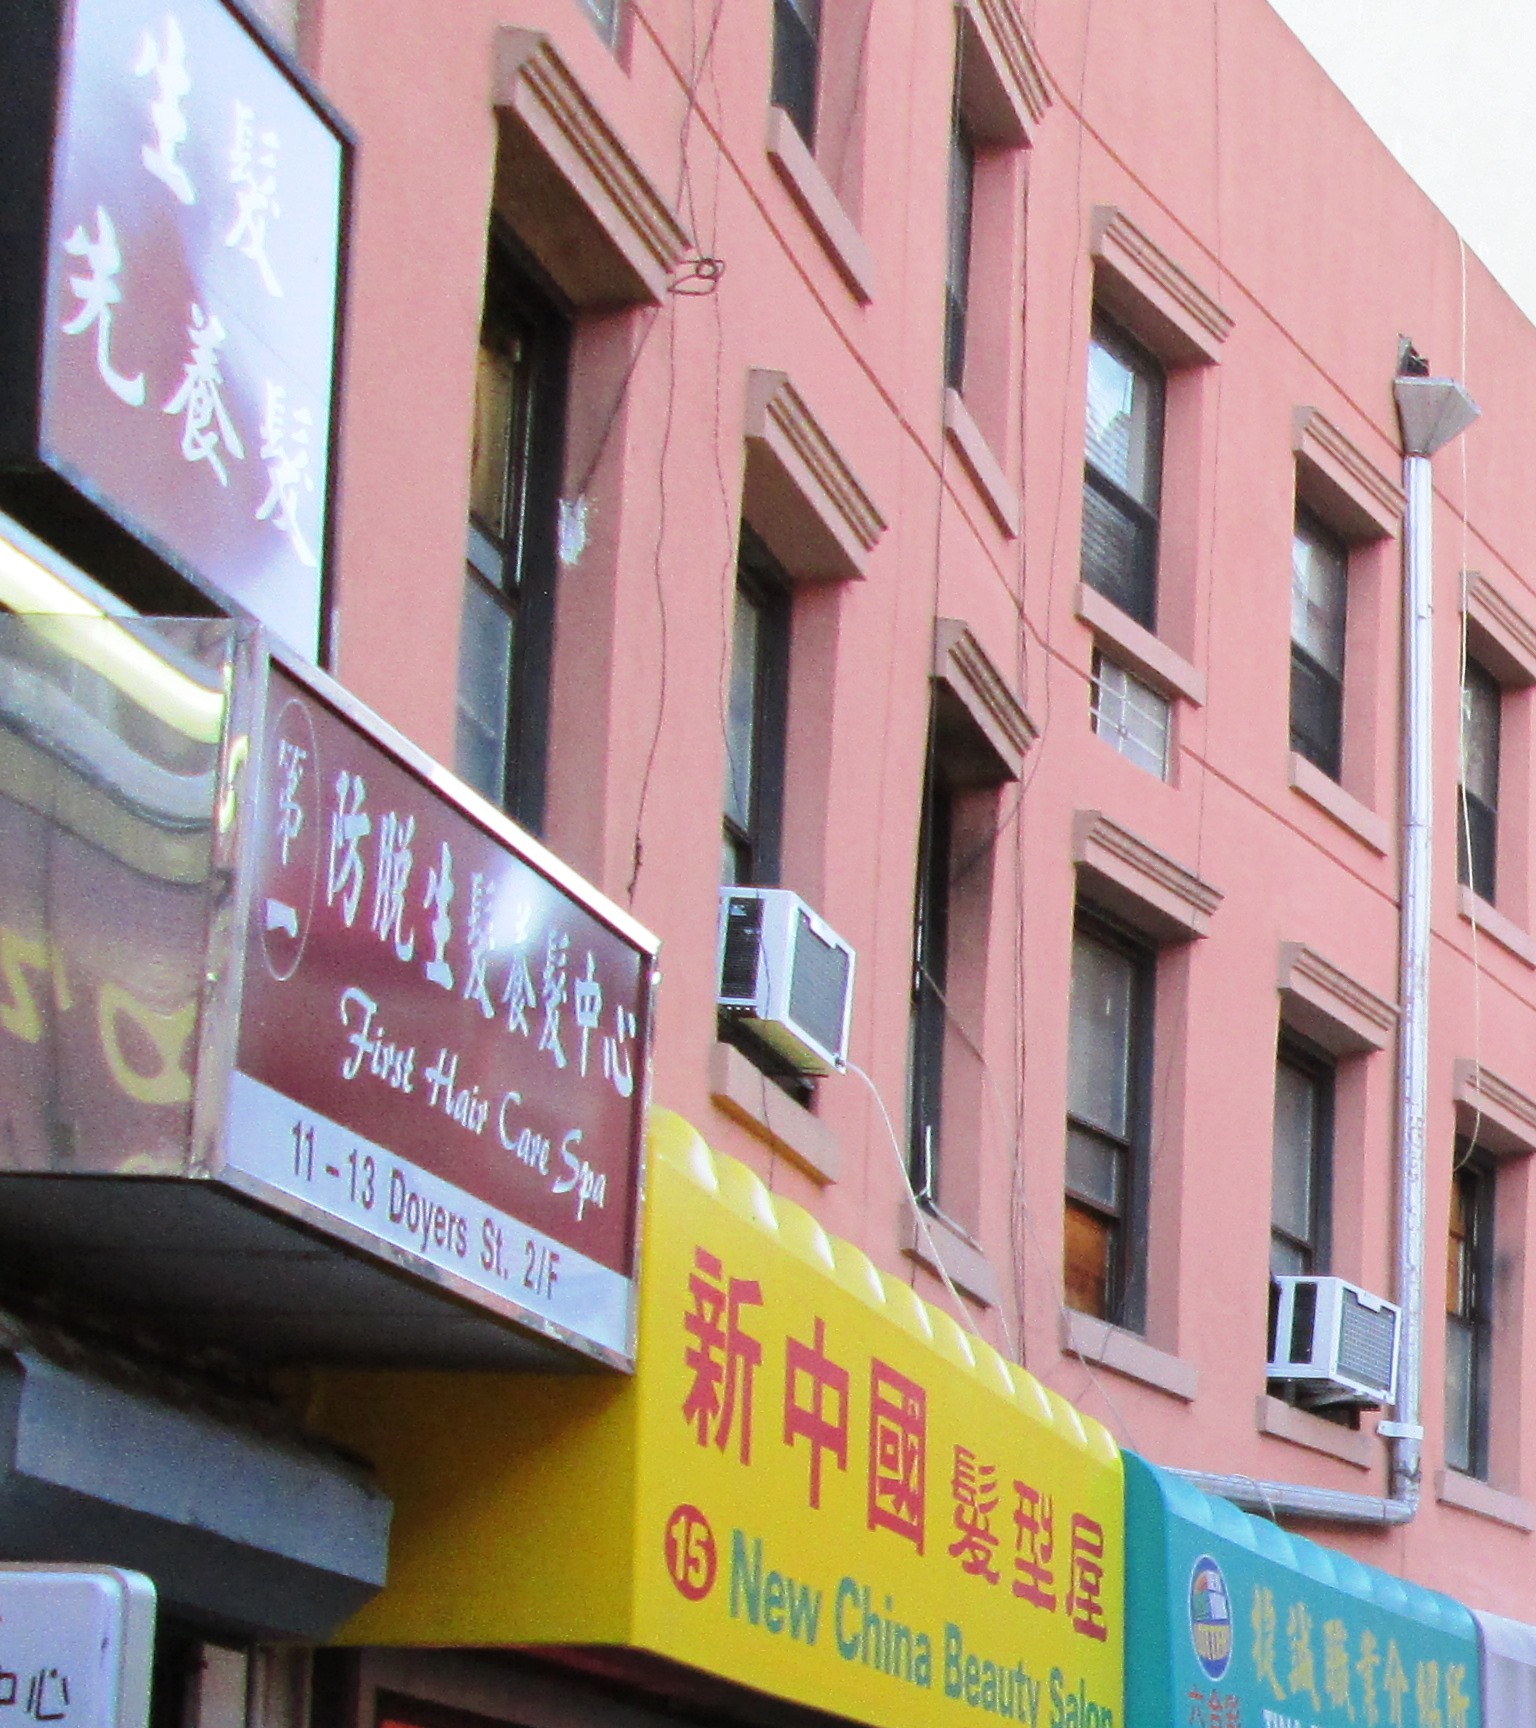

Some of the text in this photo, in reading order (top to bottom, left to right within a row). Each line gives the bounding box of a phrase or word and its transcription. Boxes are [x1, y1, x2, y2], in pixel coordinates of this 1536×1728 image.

[340, 986, 607, 1221] First Hair Care Spa
[388, 1165, 468, 1258] Doyers
[480, 1209, 509, 1281] St.
[525, 1238, 561, 1301] 2/F
[681, 1244, 1108, 1643] 新中國髮型屋
[671, 1516, 708, 1591] 15
[729, 1527, 823, 1646] New
[834, 1575, 932, 1690] China
